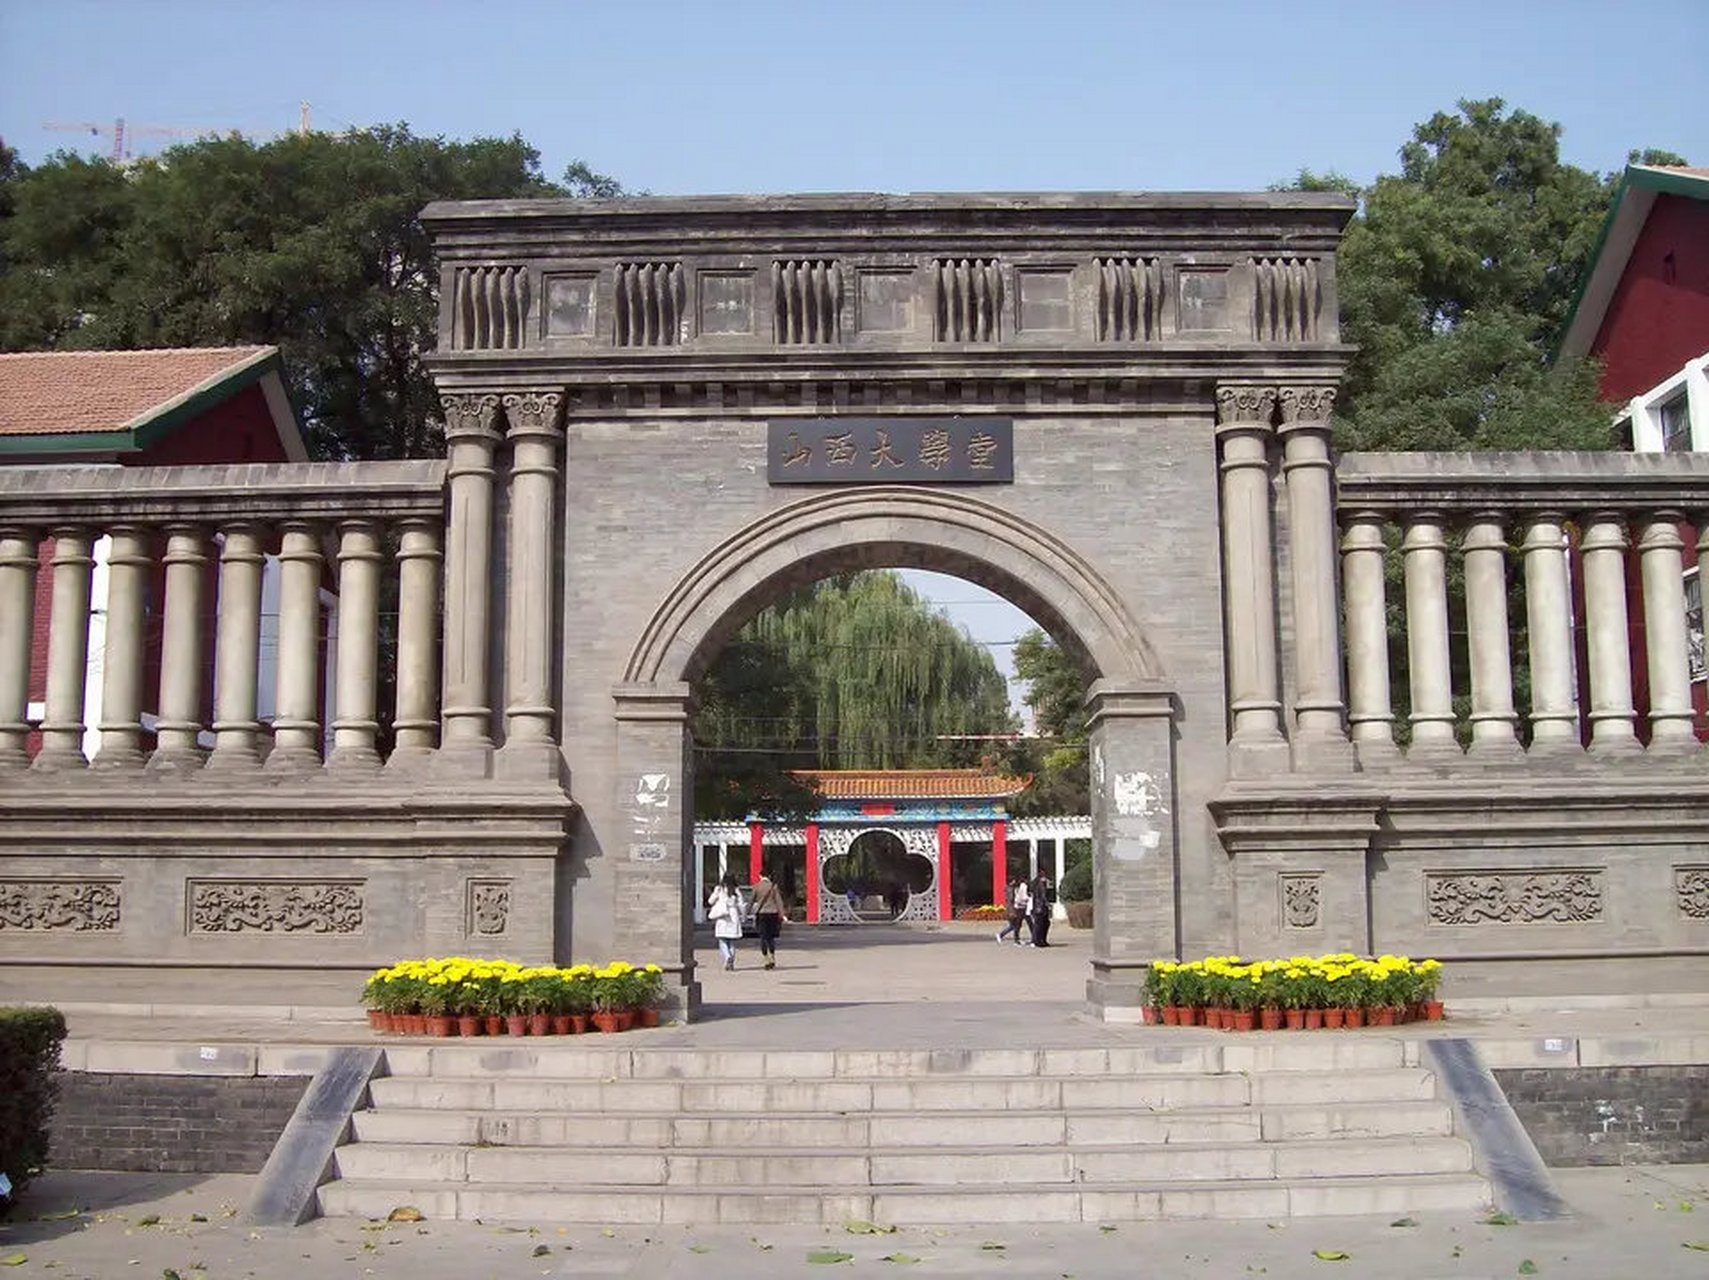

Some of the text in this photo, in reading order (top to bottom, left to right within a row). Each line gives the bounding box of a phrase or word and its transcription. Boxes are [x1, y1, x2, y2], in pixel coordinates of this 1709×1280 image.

[783, 429, 998, 471] 山西大學堂
